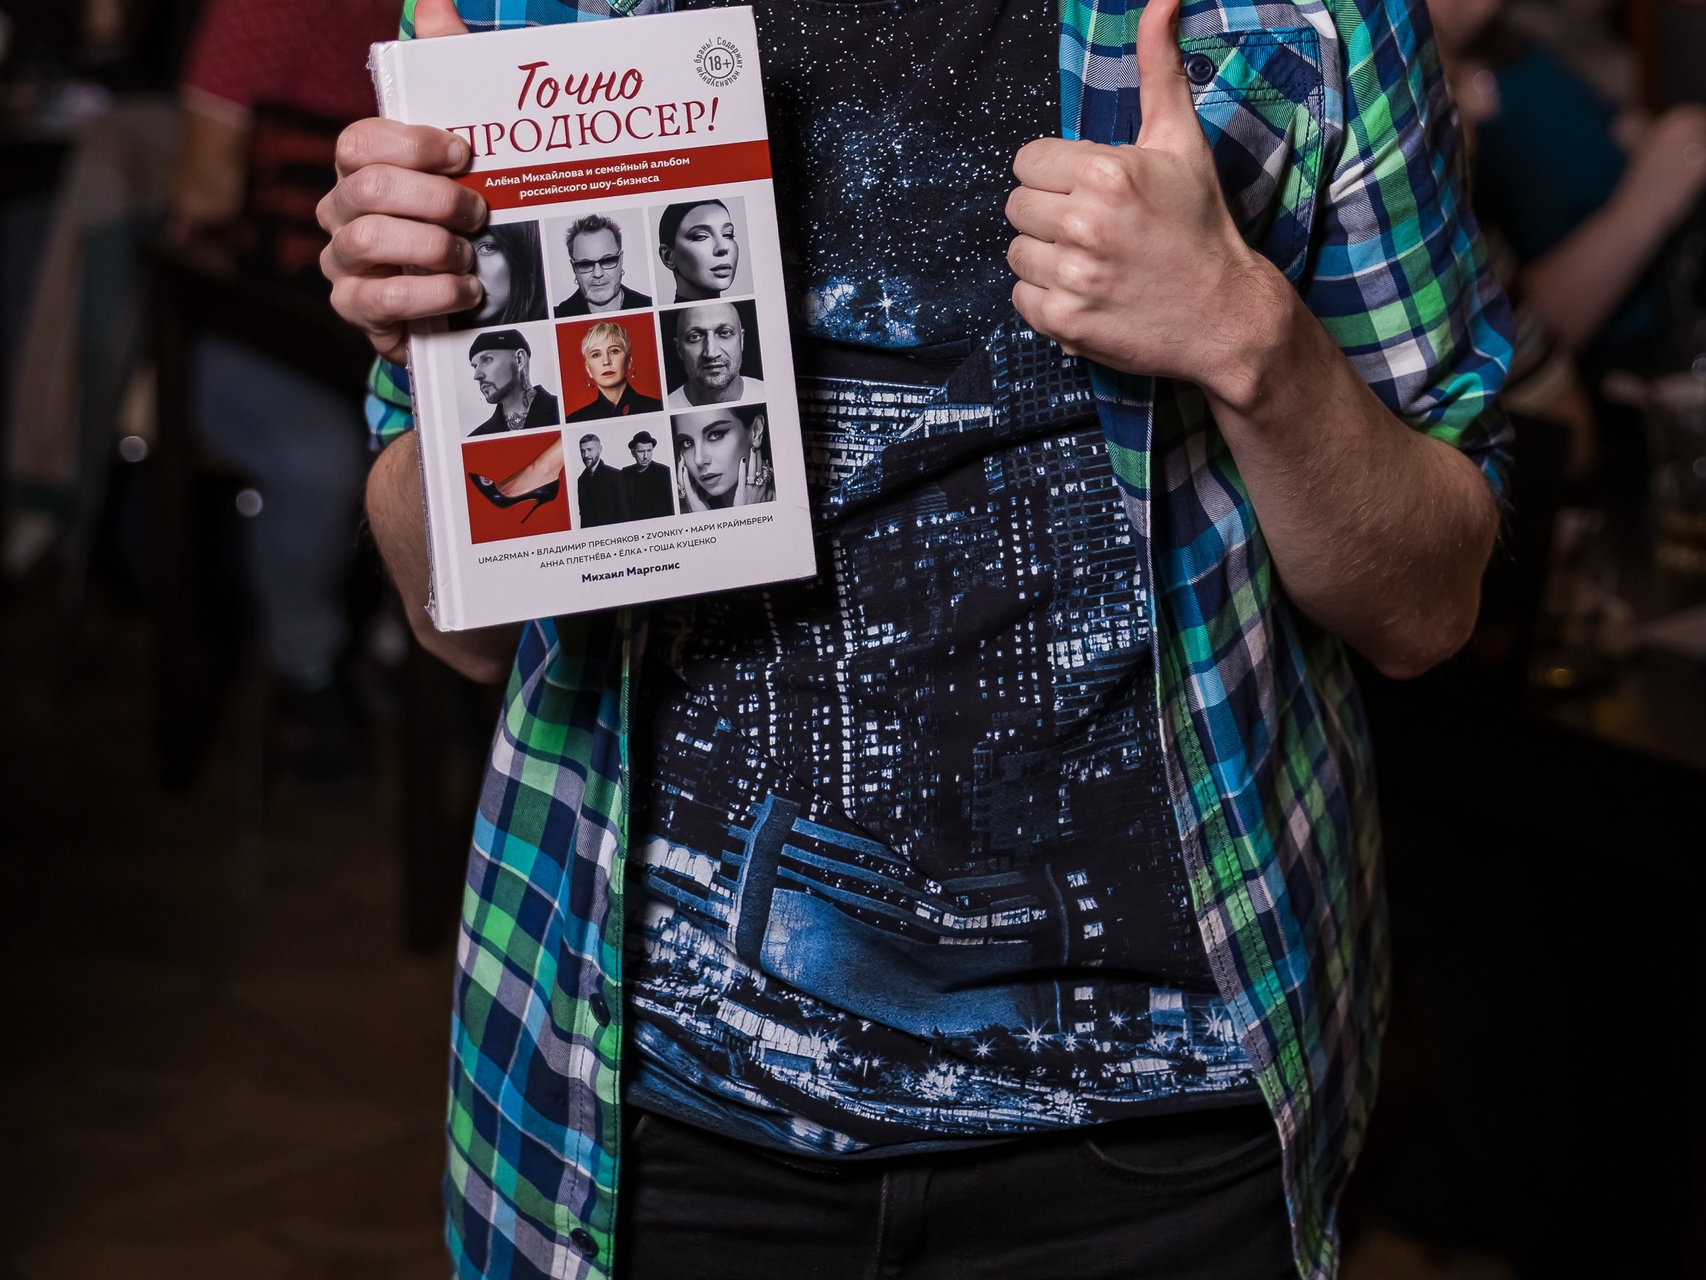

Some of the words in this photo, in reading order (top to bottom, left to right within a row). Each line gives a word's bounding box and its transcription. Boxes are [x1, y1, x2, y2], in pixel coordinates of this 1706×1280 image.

[708, 56, 732, 71] 18+
[716, 36, 742, 68] Содержит
[517, 60, 644, 111] Точно
[445, 96, 719, 158] ПРОДЮСЕР!
[485, 176, 520, 188] Алёна
[522, 170, 584, 184] Михайлова
[586, 168, 593, 176] и
[594, 160, 648, 175] семейный
[650, 156, 690, 169] альбом
[519, 181, 588, 200] российского
[590, 174, 660, 192] шоу-бизнеса
[478, 550, 530, 564] UMA2RMAN
[536, 542, 587, 556] ВЛАДИМИР
[588, 534, 640, 548] ПРЕСНЯКОВ
[646, 528, 684, 540] ZVONKIY
[690, 523, 716, 534] МАРИ
[717, 515, 774, 530] КРАЙМБРЕРИ
[540, 559, 565, 569] АННА
[566, 551, 612, 565] ПЛЕТНЁВА
[619, 547, 642, 558] ЁЛКА
[649, 542, 676, 553] ГОША
[676, 536, 717, 550] КУЦЕНКО
[581, 569, 625, 583] Михаил
[626, 562, 681, 577] Марголис
